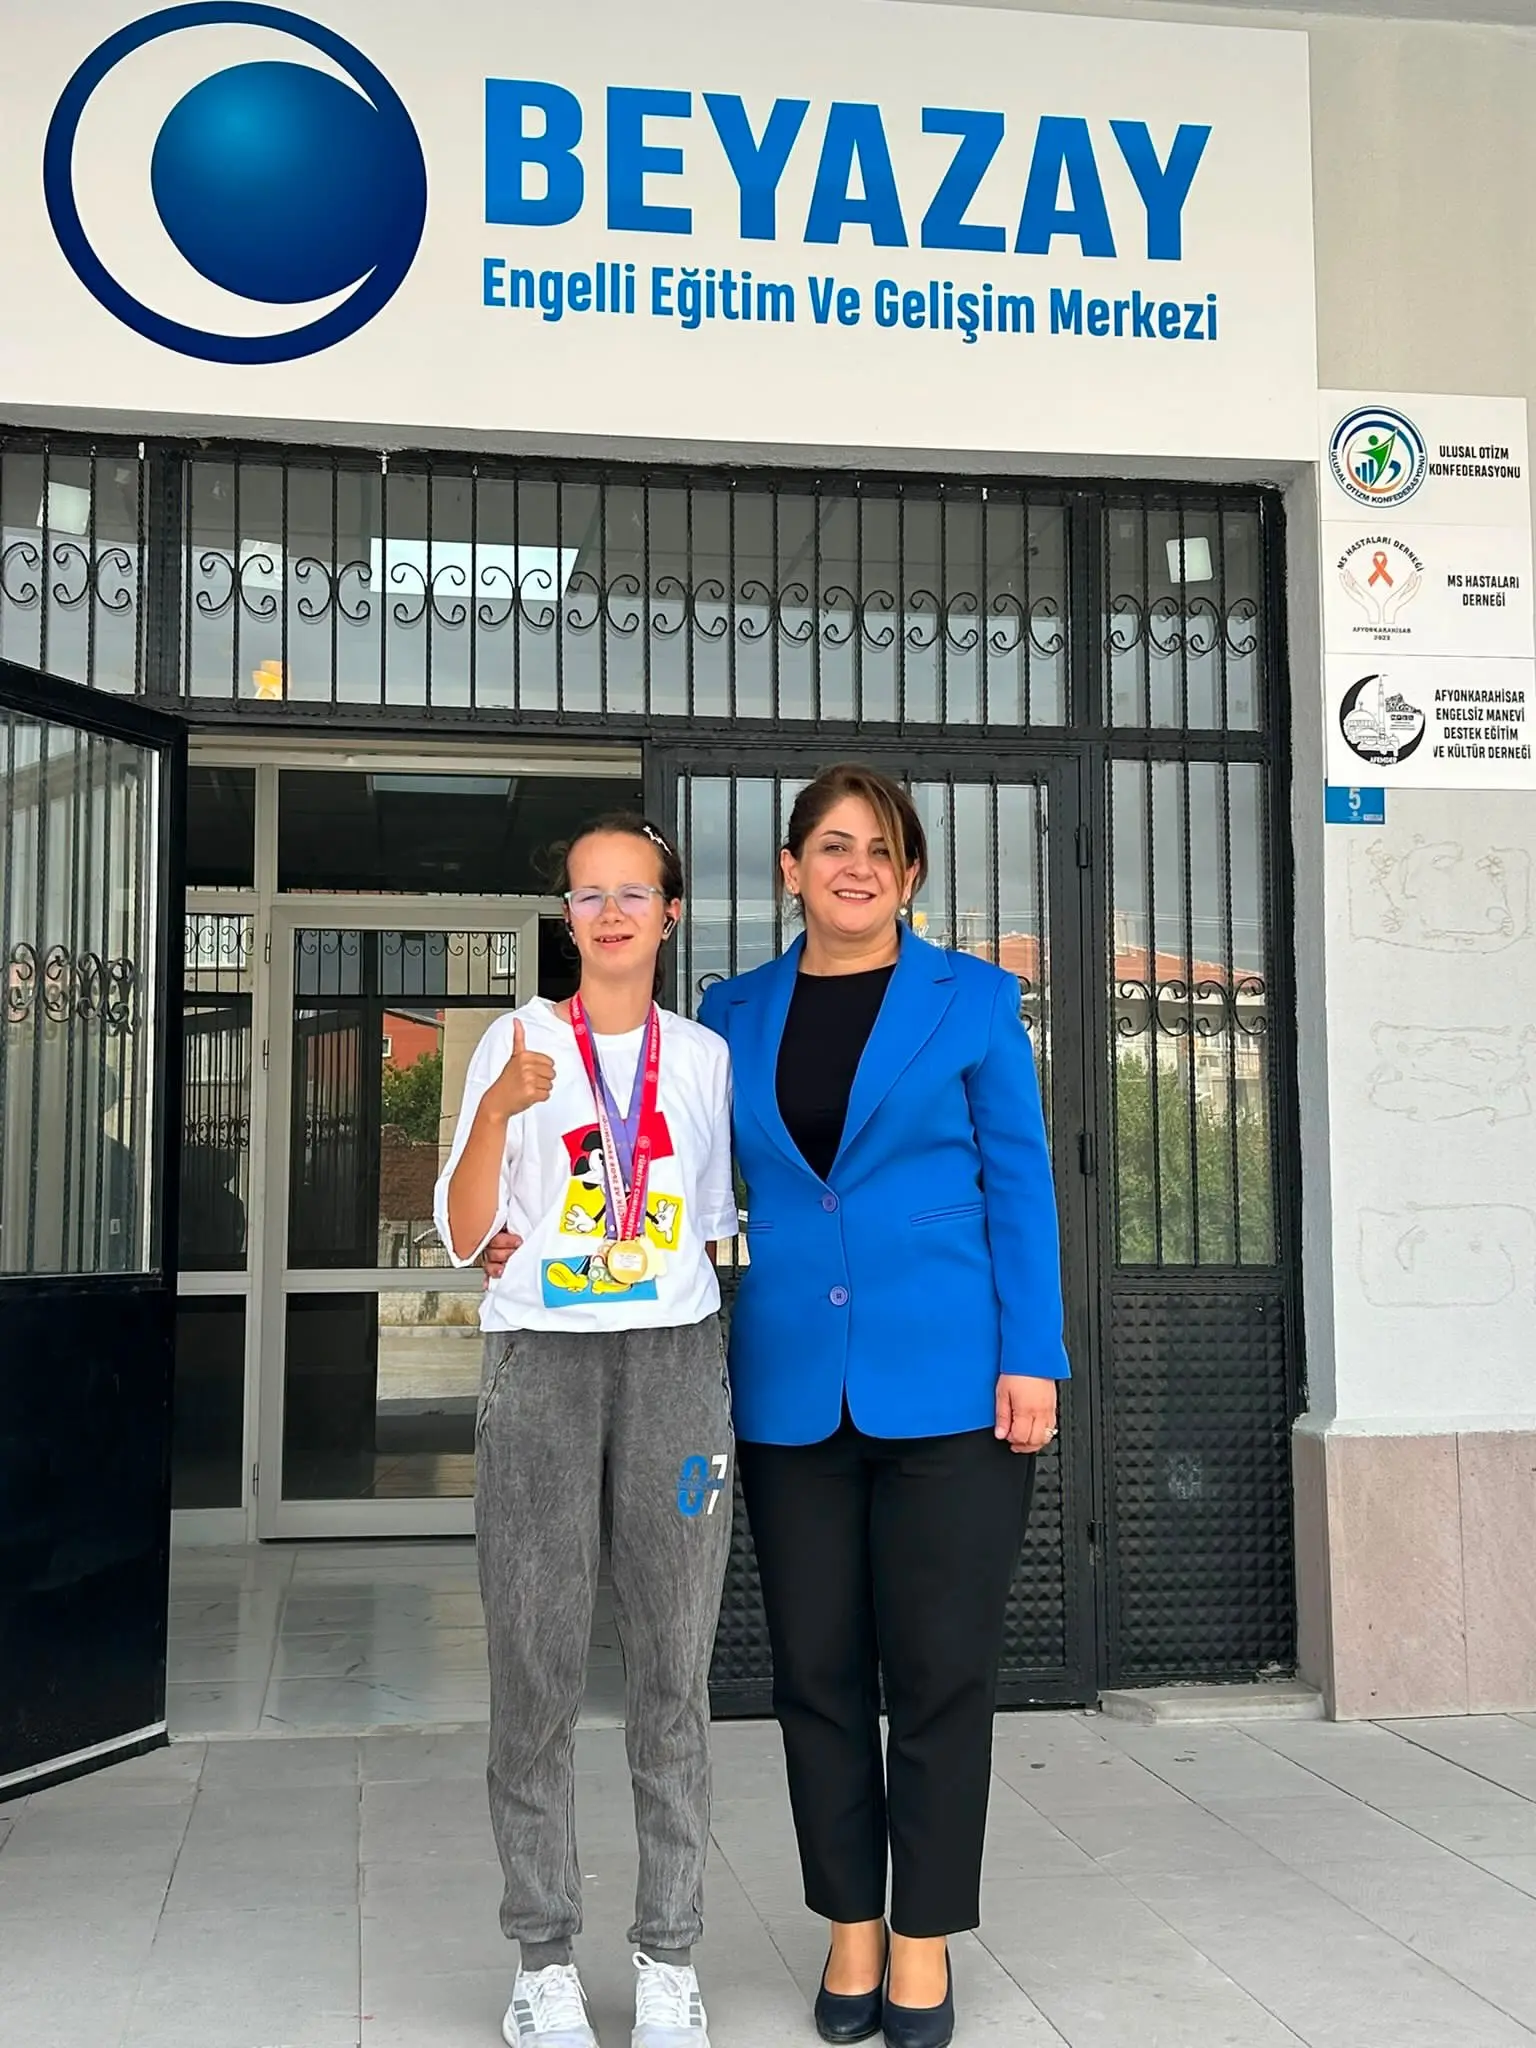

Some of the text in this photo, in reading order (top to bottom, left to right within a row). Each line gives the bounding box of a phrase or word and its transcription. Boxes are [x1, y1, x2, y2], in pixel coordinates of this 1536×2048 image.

[485, 78, 1212, 260] BEYAZAY
[483, 257, 1217, 344] Engelli Eğitim Ve Gelişim Merkezi
[1439, 444, 1509, 459] ULUSAL OTİZM
[1331, 451, 1426, 503] ULUSAL OTİZM KONFEDERASYONU
[1429, 463, 1521, 478] KONFEDERASYONU
[1337, 556, 1348, 569] MS
[1345, 536, 1391, 557] HASTALARI
[1447, 574, 1520, 589] MS HASTALARI
[1462, 592, 1506, 607] DERNEĞİ
[1434, 688, 1525, 703] AFYONKARAHİSAR
[1436, 706, 1525, 722] ENGELSİZ MANEVİ
[1444, 725, 1519, 740] DESTEK EĞİTİM
[1433, 743, 1532, 760] VE KÜLTÜR DERNEĞİ
[1348, 788, 1361, 810] 5
[677, 1454, 728, 1517] 07
